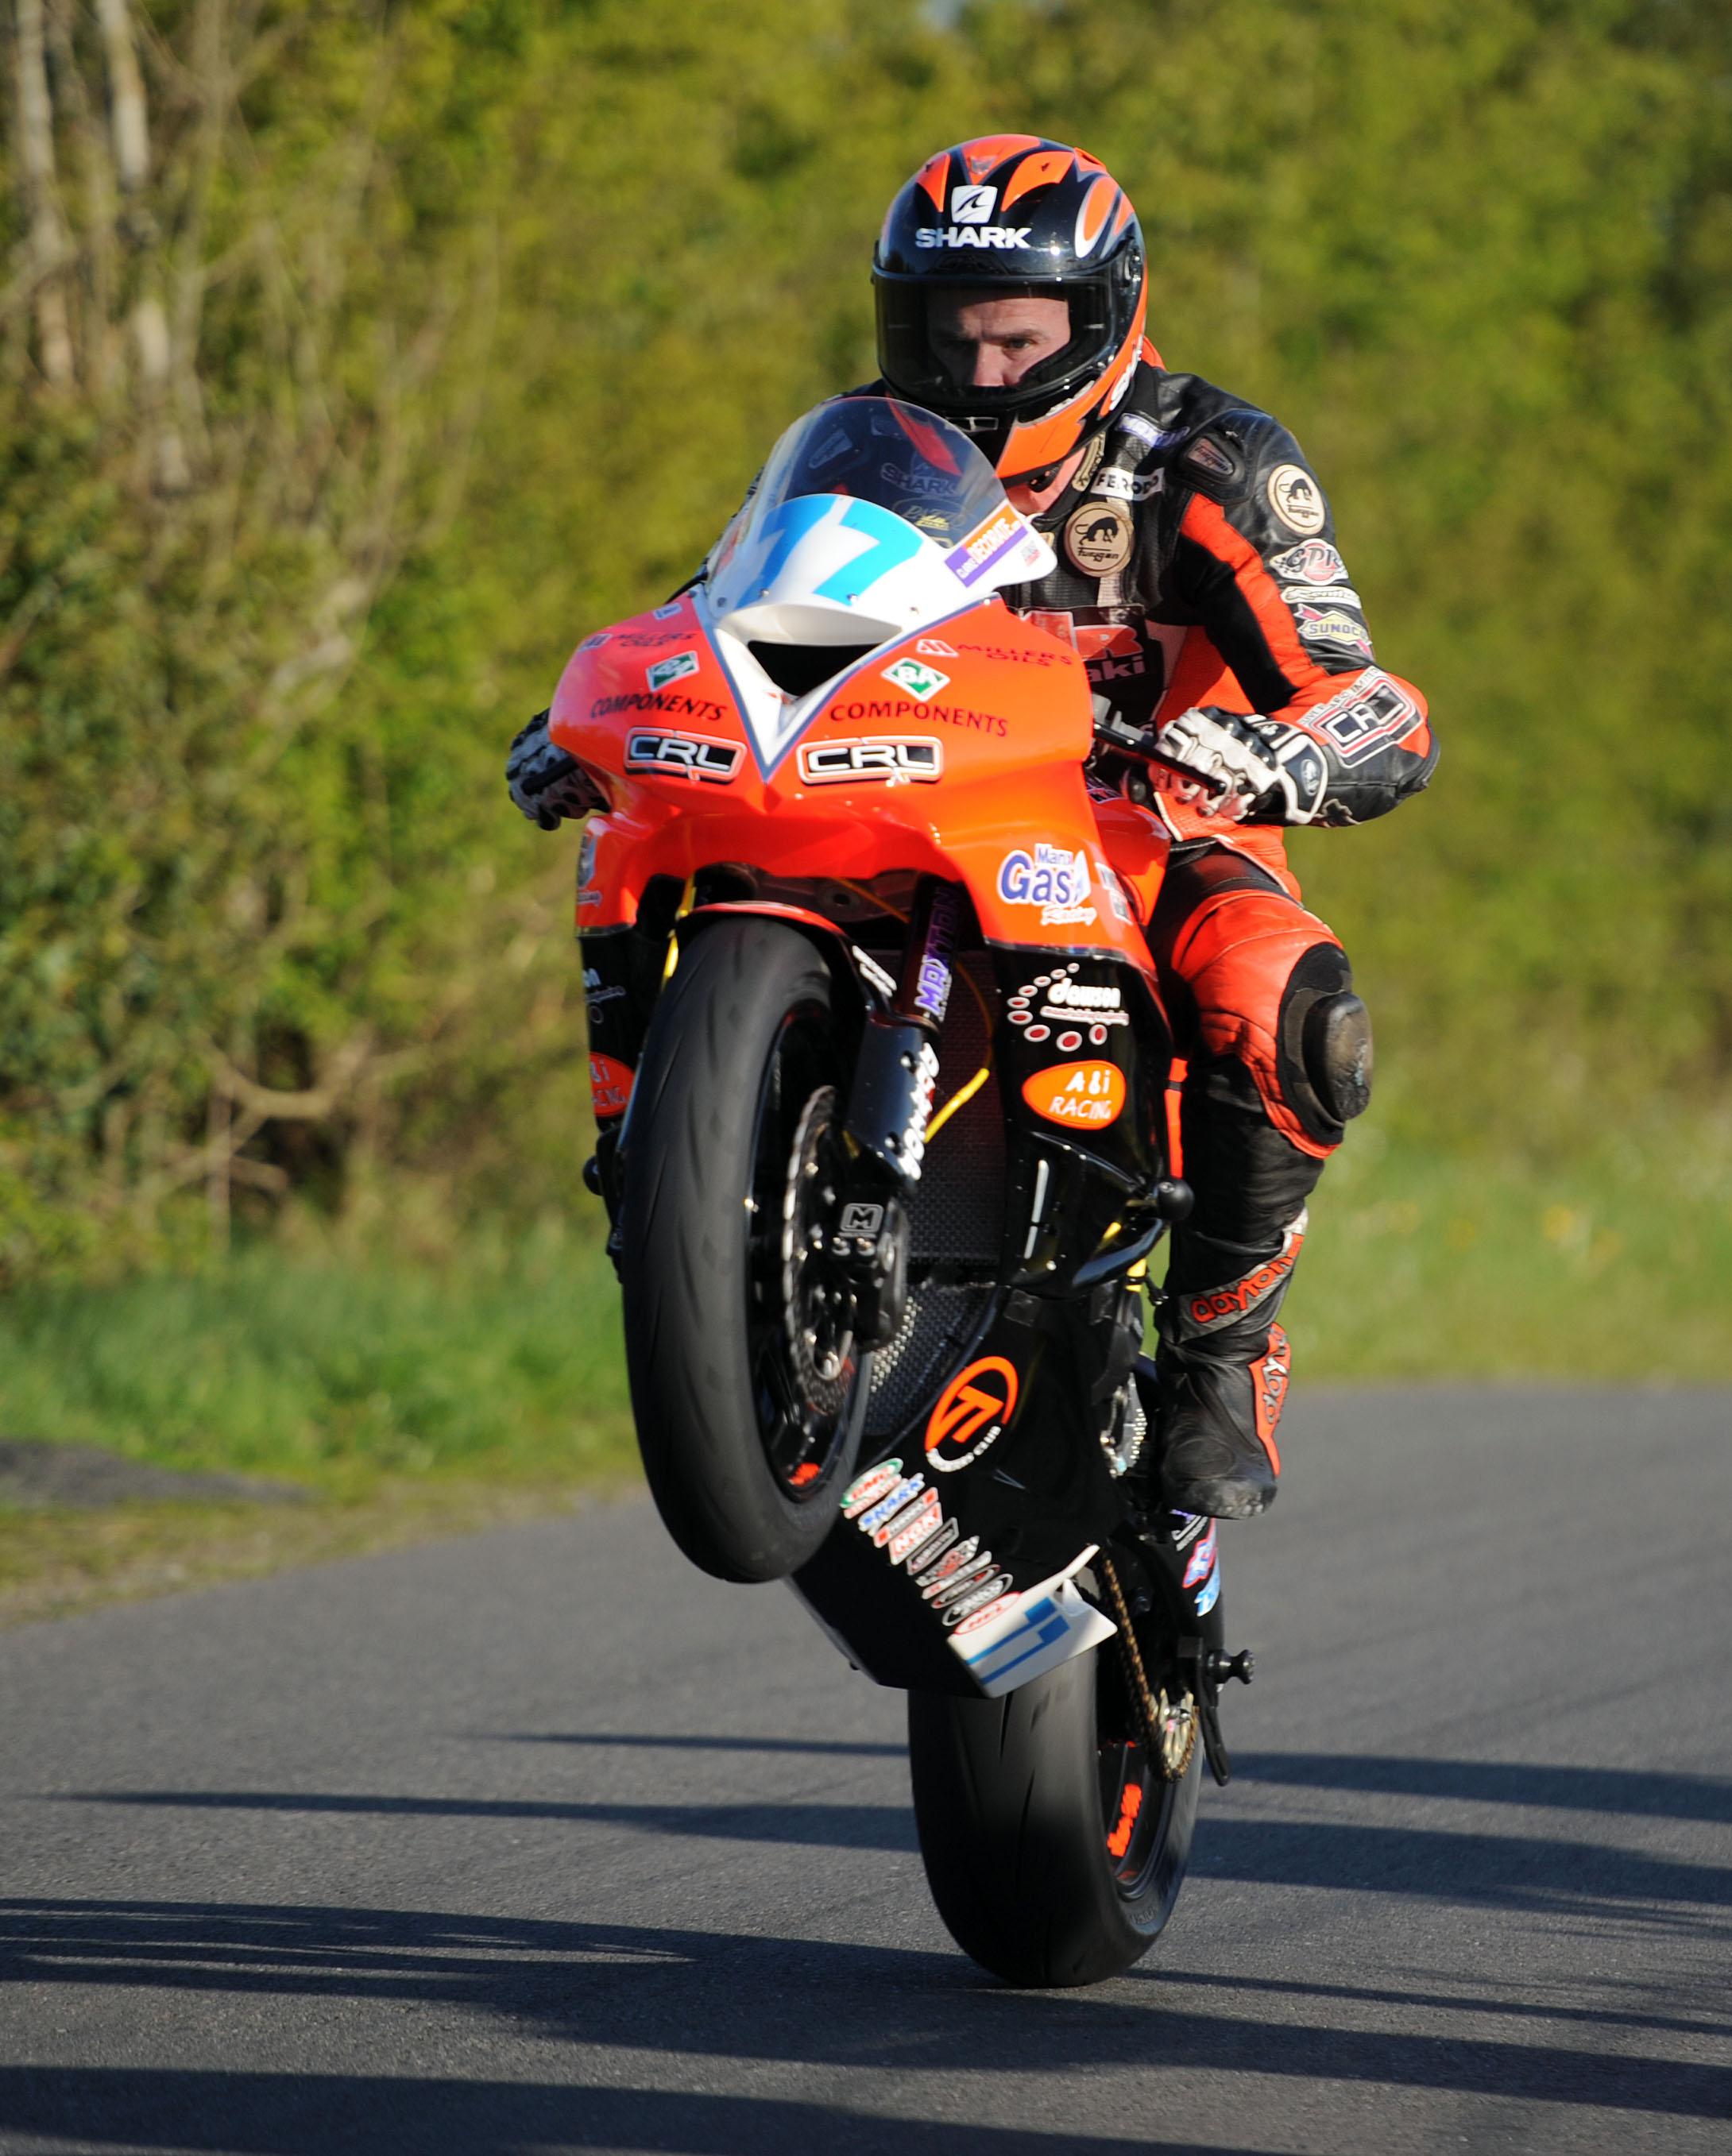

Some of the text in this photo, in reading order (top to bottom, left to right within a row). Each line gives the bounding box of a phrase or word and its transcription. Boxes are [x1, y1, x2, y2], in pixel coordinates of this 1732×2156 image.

[915, 227, 1032, 249] SHARK
[958, 643, 1073, 666] MILLERS
[987, 654, 1052, 667] OILS
[591, 692, 728, 721] COMPONENTS
[829, 701, 1009, 738] COMPONENTS
[629, 736, 731, 771] CRL
[807, 744, 936, 772] CRL
[1001, 854, 1073, 904] Gas
[1049, 1095, 1112, 1120] RACING
